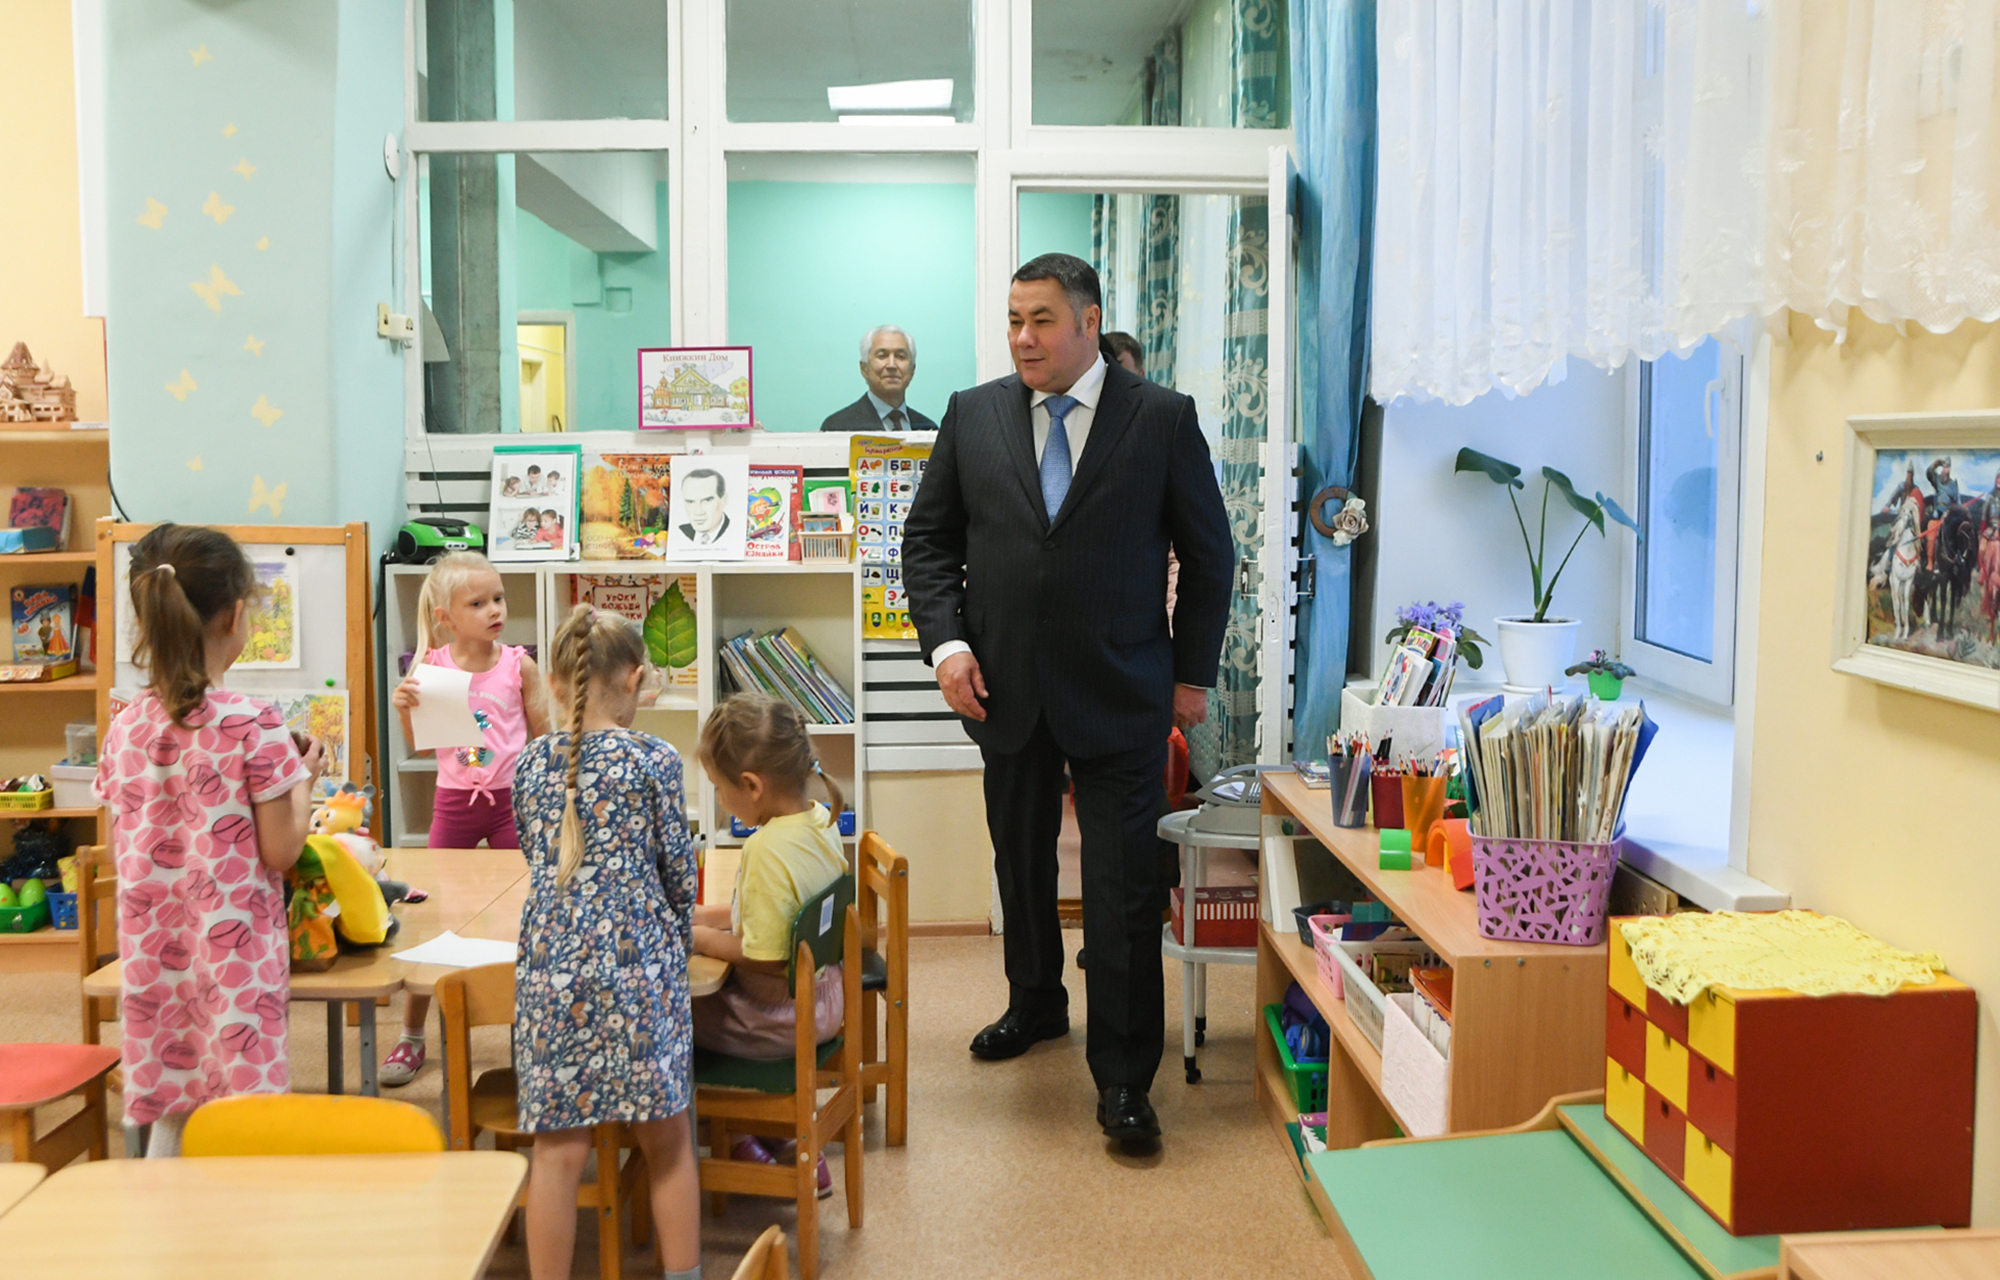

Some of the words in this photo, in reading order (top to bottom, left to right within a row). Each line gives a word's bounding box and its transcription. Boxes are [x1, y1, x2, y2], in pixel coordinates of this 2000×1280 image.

[662, 354, 706, 362] Книжкин
[708, 353, 729, 362] Дом
[860, 459, 870, 470] А
[890, 460, 899, 471] Б
[919, 460, 928, 471] В
[860, 482, 869, 492] Е
[890, 479, 899, 493] Ё
[860, 501, 869, 513] Й
[889, 503, 898, 514] К
[858, 525, 869, 536] О
[889, 525, 898, 536] П
[888, 547, 899, 558] Ф
[886, 568, 899, 580] Щ
[606, 593, 636, 602] УРОКИ
[888, 590, 897, 601] Э
